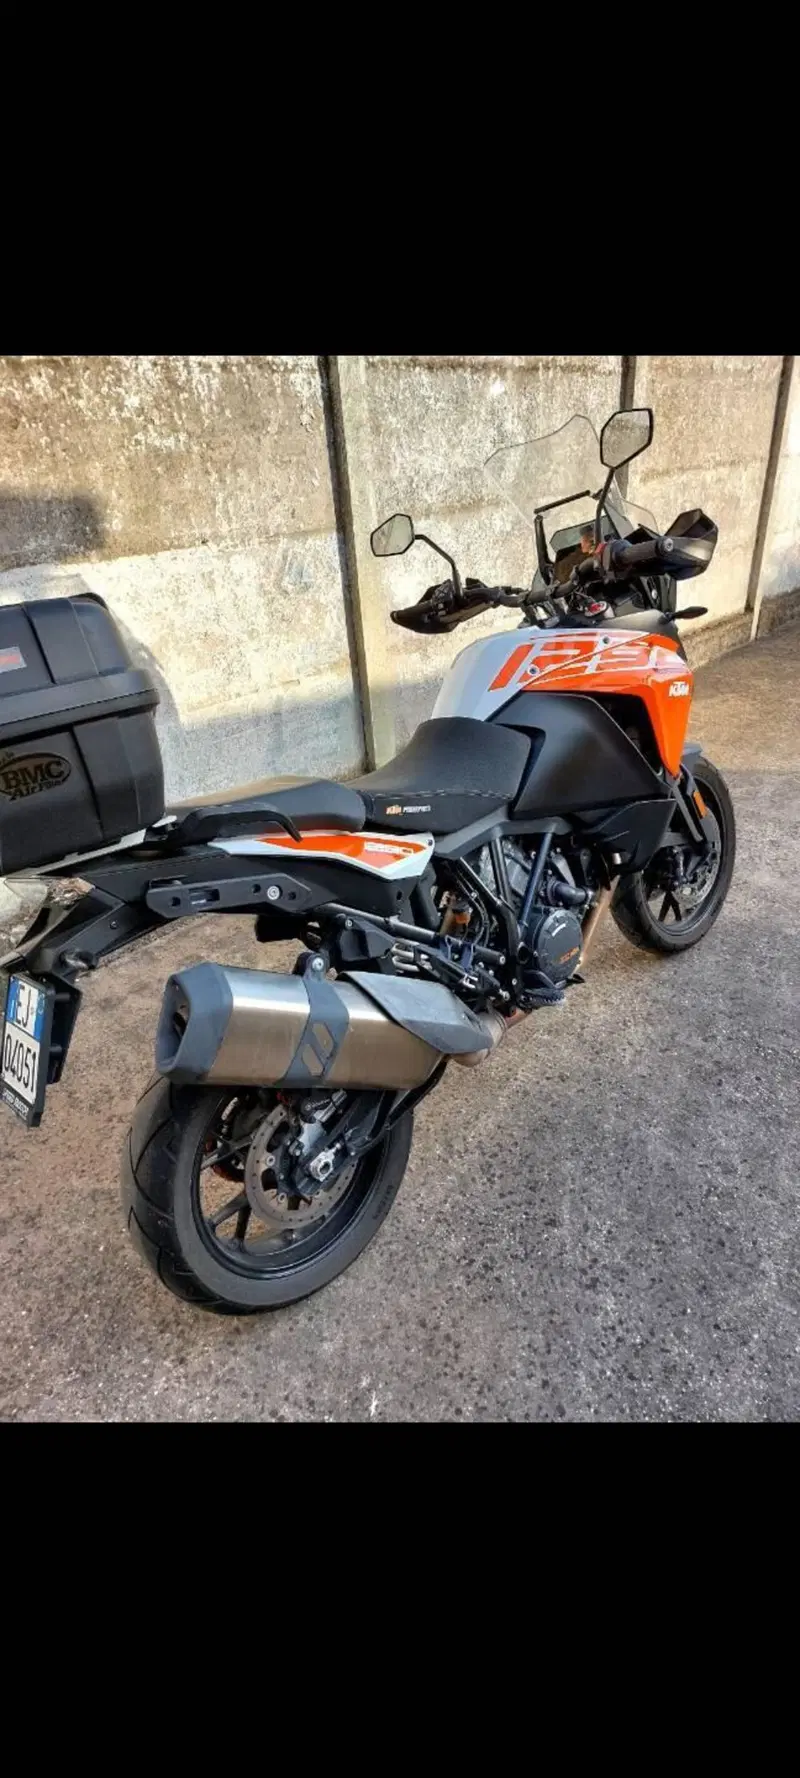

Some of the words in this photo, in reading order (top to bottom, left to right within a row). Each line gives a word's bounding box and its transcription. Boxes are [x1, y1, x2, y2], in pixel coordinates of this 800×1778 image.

[668, 681, 690, 697] KTM
[1, 760, 65, 790] BMC
[15, 983, 32, 1027] EJ
[4, 1033, 37, 1092] 04051
